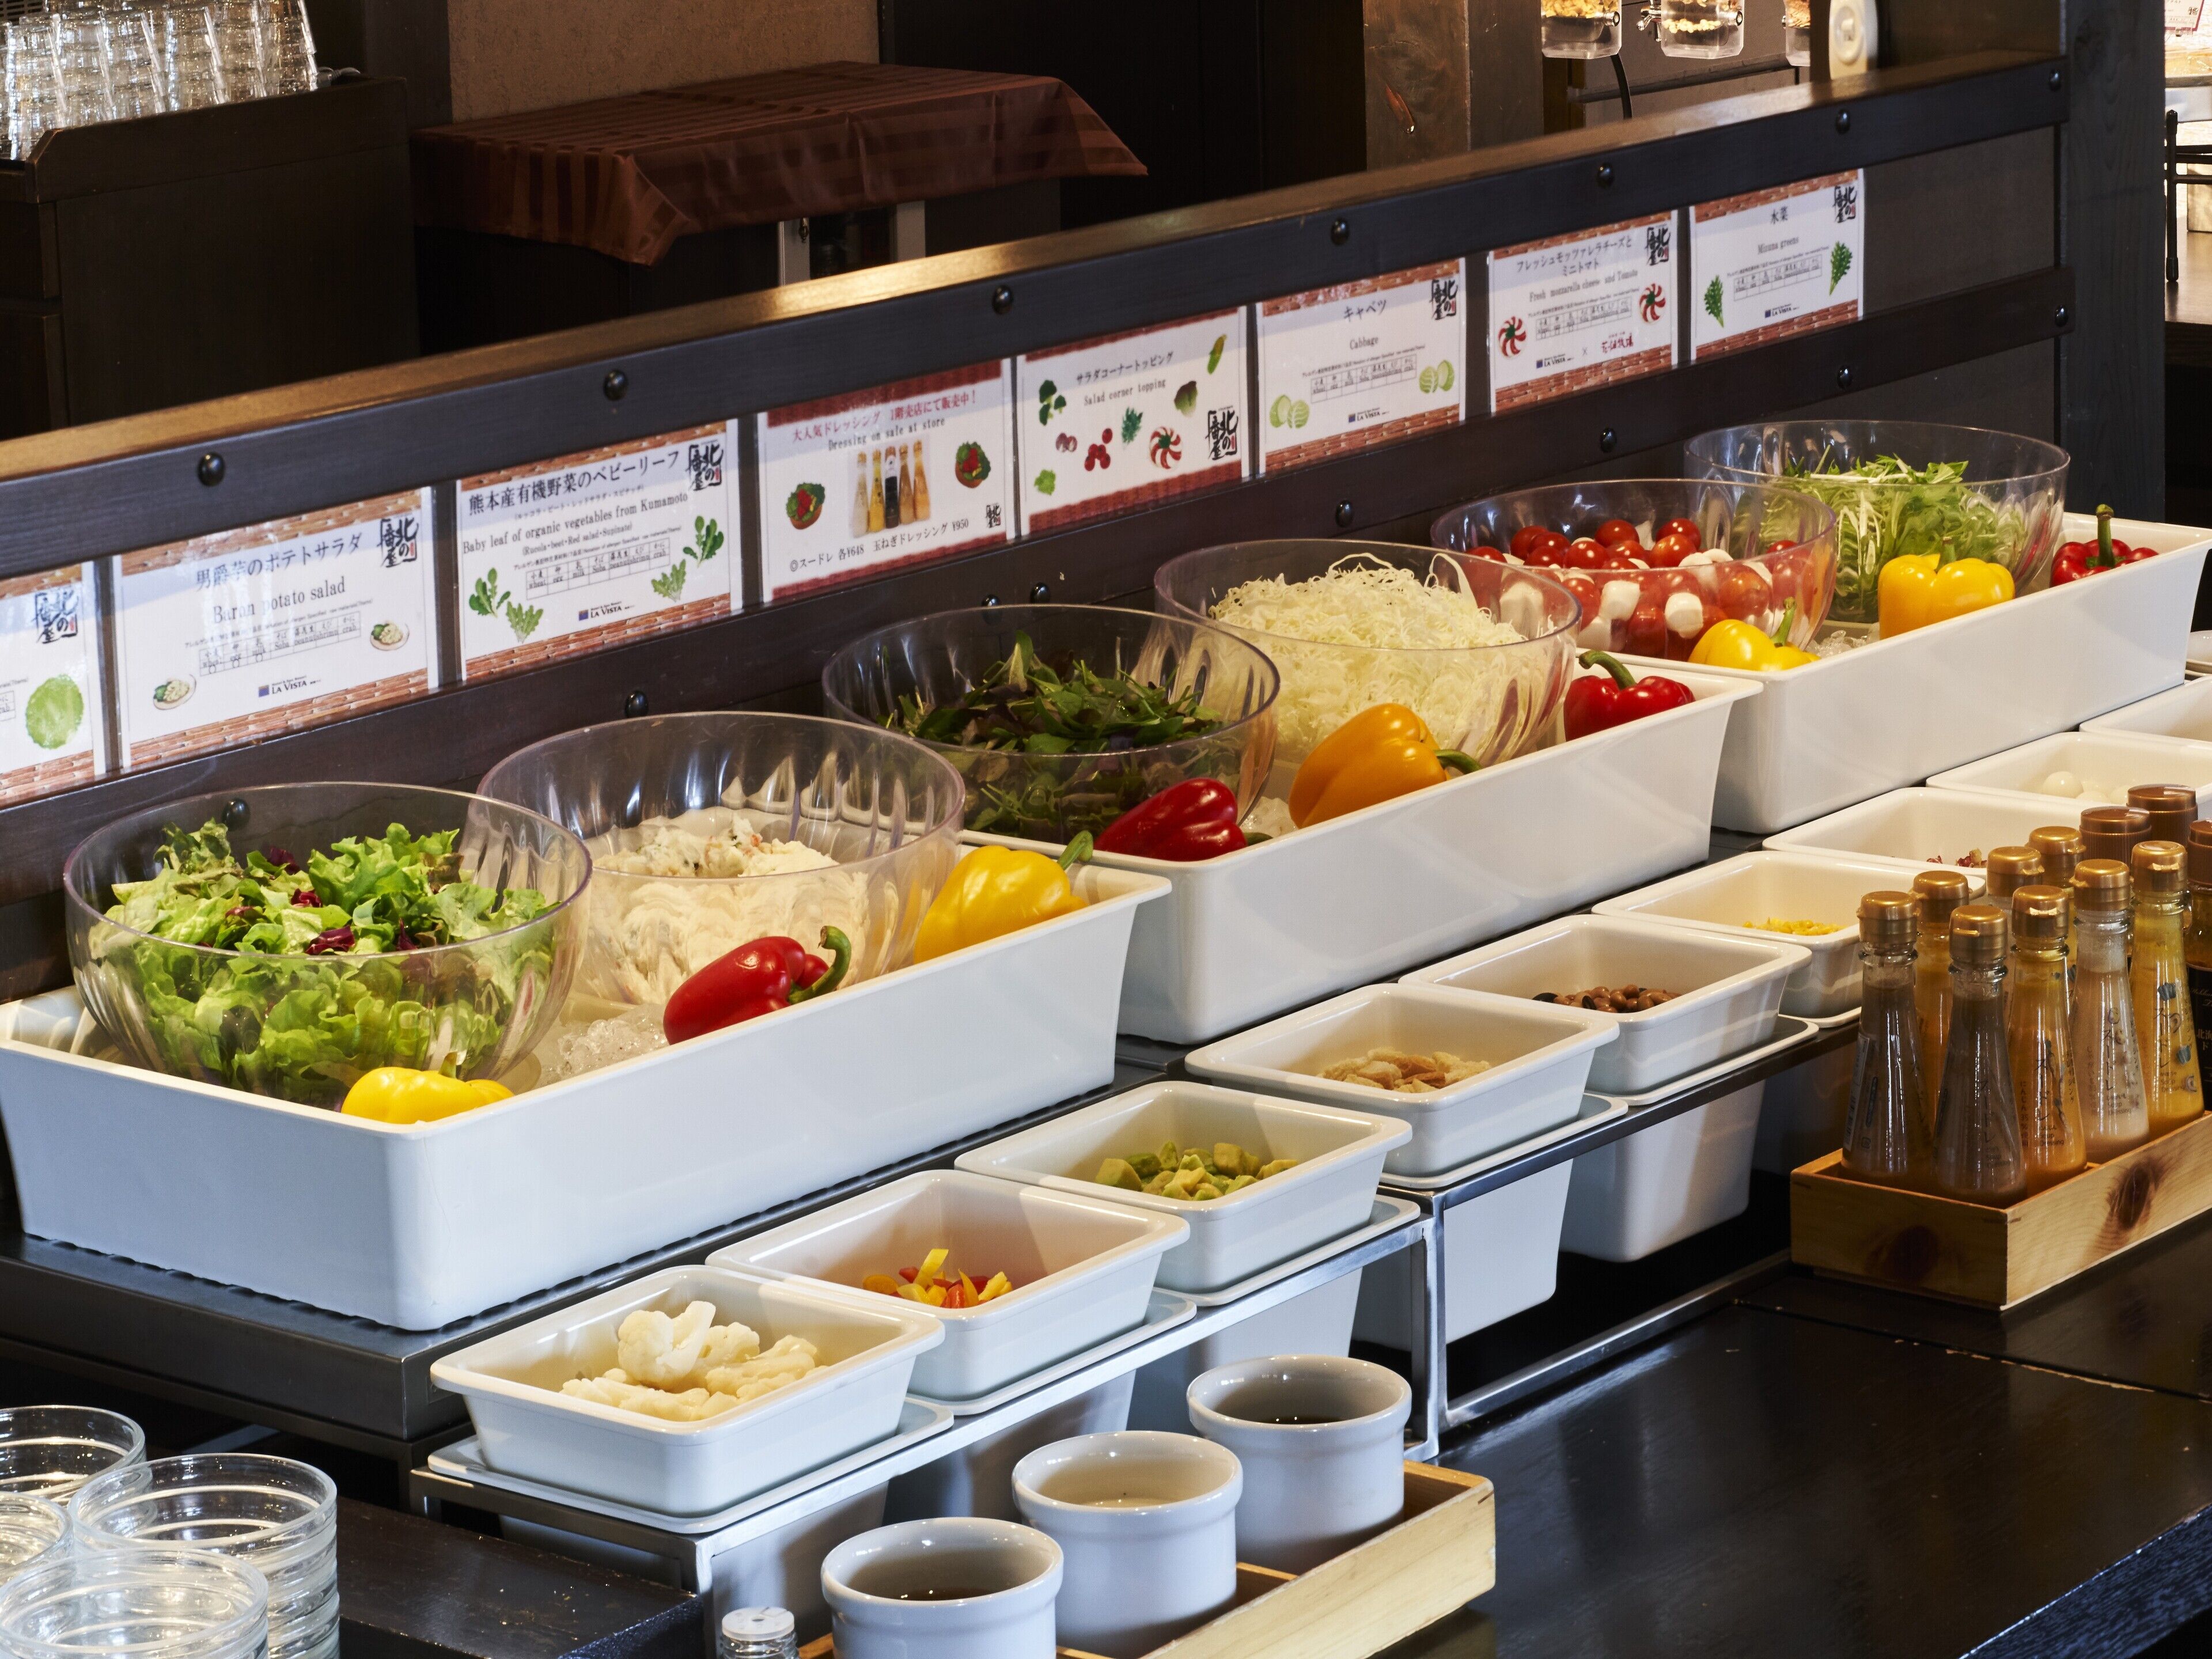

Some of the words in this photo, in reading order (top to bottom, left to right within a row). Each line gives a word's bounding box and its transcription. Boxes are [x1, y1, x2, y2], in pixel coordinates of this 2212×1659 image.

[1780, 237, 1800, 250] greens
[1563, 259, 1600, 276] ミニトマト
[1529, 289, 1546, 302] Fresh
[1582, 279, 1600, 289] cheese
[1605, 272, 1615, 283] and
[1344, 298, 1388, 321] キャベツ
[1350, 335, 1379, 350] Cabbage
[1076, 351, 1174, 385] サラダコーナートッピング
[1084, 391, 1105, 406] Salad
[1109, 388, 1134, 401] corner
[1138, 378, 1166, 393] topping
[793, 410, 880, 442] 大人気ドレッシング
[1365, 410, 1381, 420] VISTA
[828, 432, 866, 451] Dressing
[872, 432, 881, 441] on
[885, 425, 903, 438] sale
[908, 422, 917, 433] at
[923, 418, 945, 430] store
[469, 450, 680, 516] 熊本産有機野菜のベビーリーフ
[463, 539, 486, 554] Baby
[490, 531, 509, 548] leaf
[513, 528, 522, 542] of
[525, 520, 561, 540] organic
[565, 509, 613, 529] vegetables
[616, 504, 637, 518] from
[641, 493, 688, 512] Kumamoto
[873, 522, 949, 552] 玉ねぎドレッシング
[952, 518, 969, 532] ¥950
[213, 603, 255, 625] Baron
[263, 589, 305, 614] potato
[310, 576, 346, 601] salad
[601, 605, 622, 615] VISTA
[271, 686, 282, 695] LA
[284, 680, 307, 691] VISTA
[2102, 1029, 2115, 1091] スードレ
[2034, 1059, 2050, 1122] スードレ
